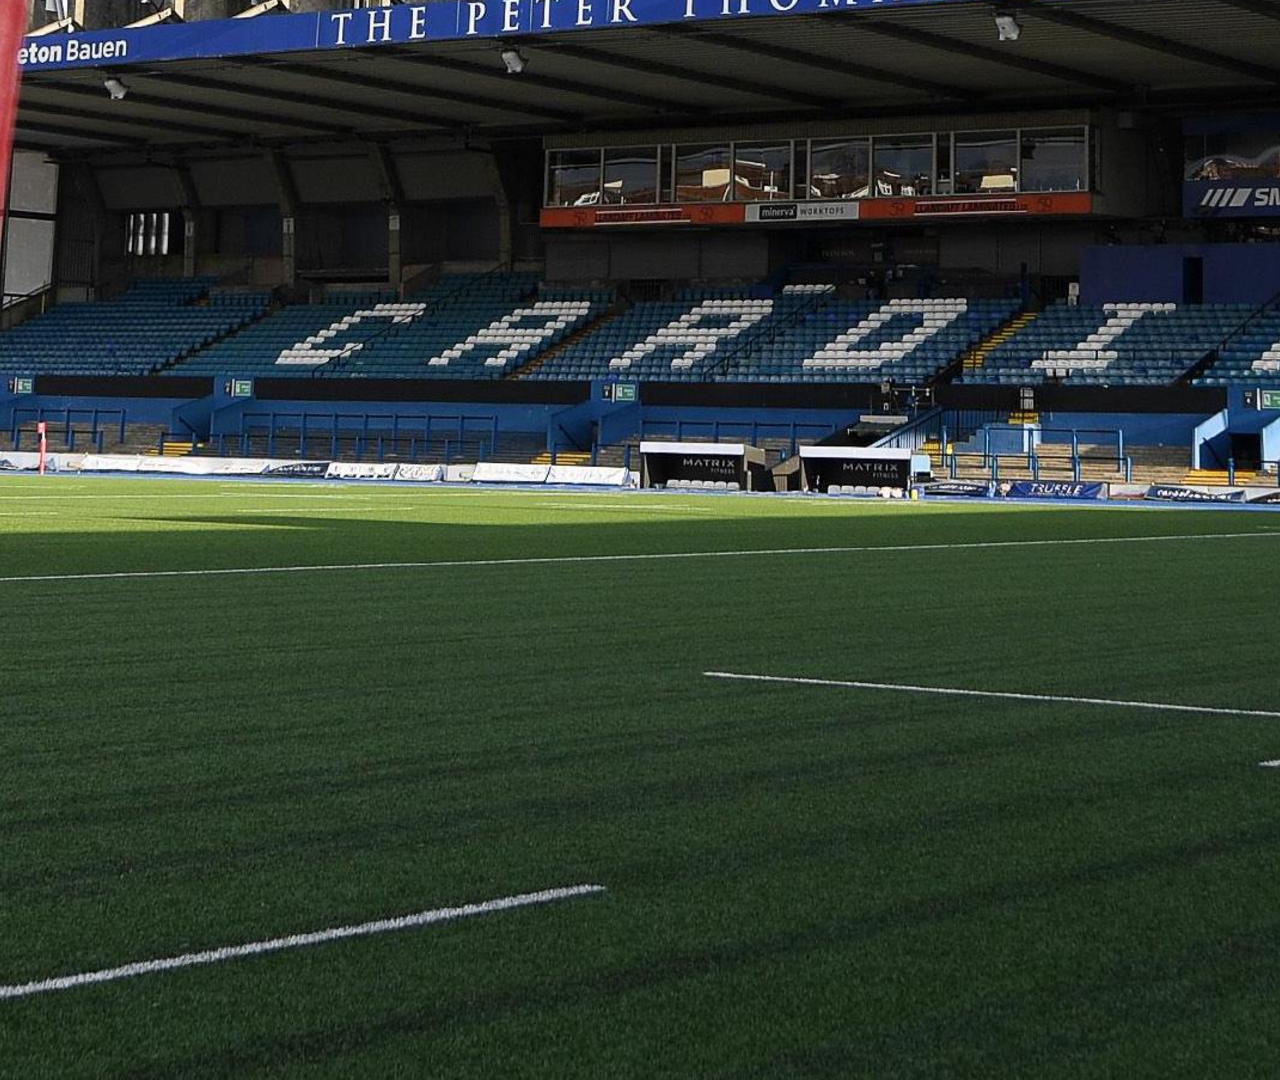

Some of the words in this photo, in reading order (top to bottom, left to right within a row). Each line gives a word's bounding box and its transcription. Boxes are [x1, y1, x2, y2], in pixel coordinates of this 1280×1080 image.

[331, 6, 426, 45] THE
[17, 42, 62, 64] eton
[66, 40, 127, 61] Bauen
[800, 206, 845, 216] WORKTOPS
[683, 458, 735, 468] MATRIX
[842, 463, 898, 472] MATRIX
[1030, 482, 1083, 495] TRUFFLE
